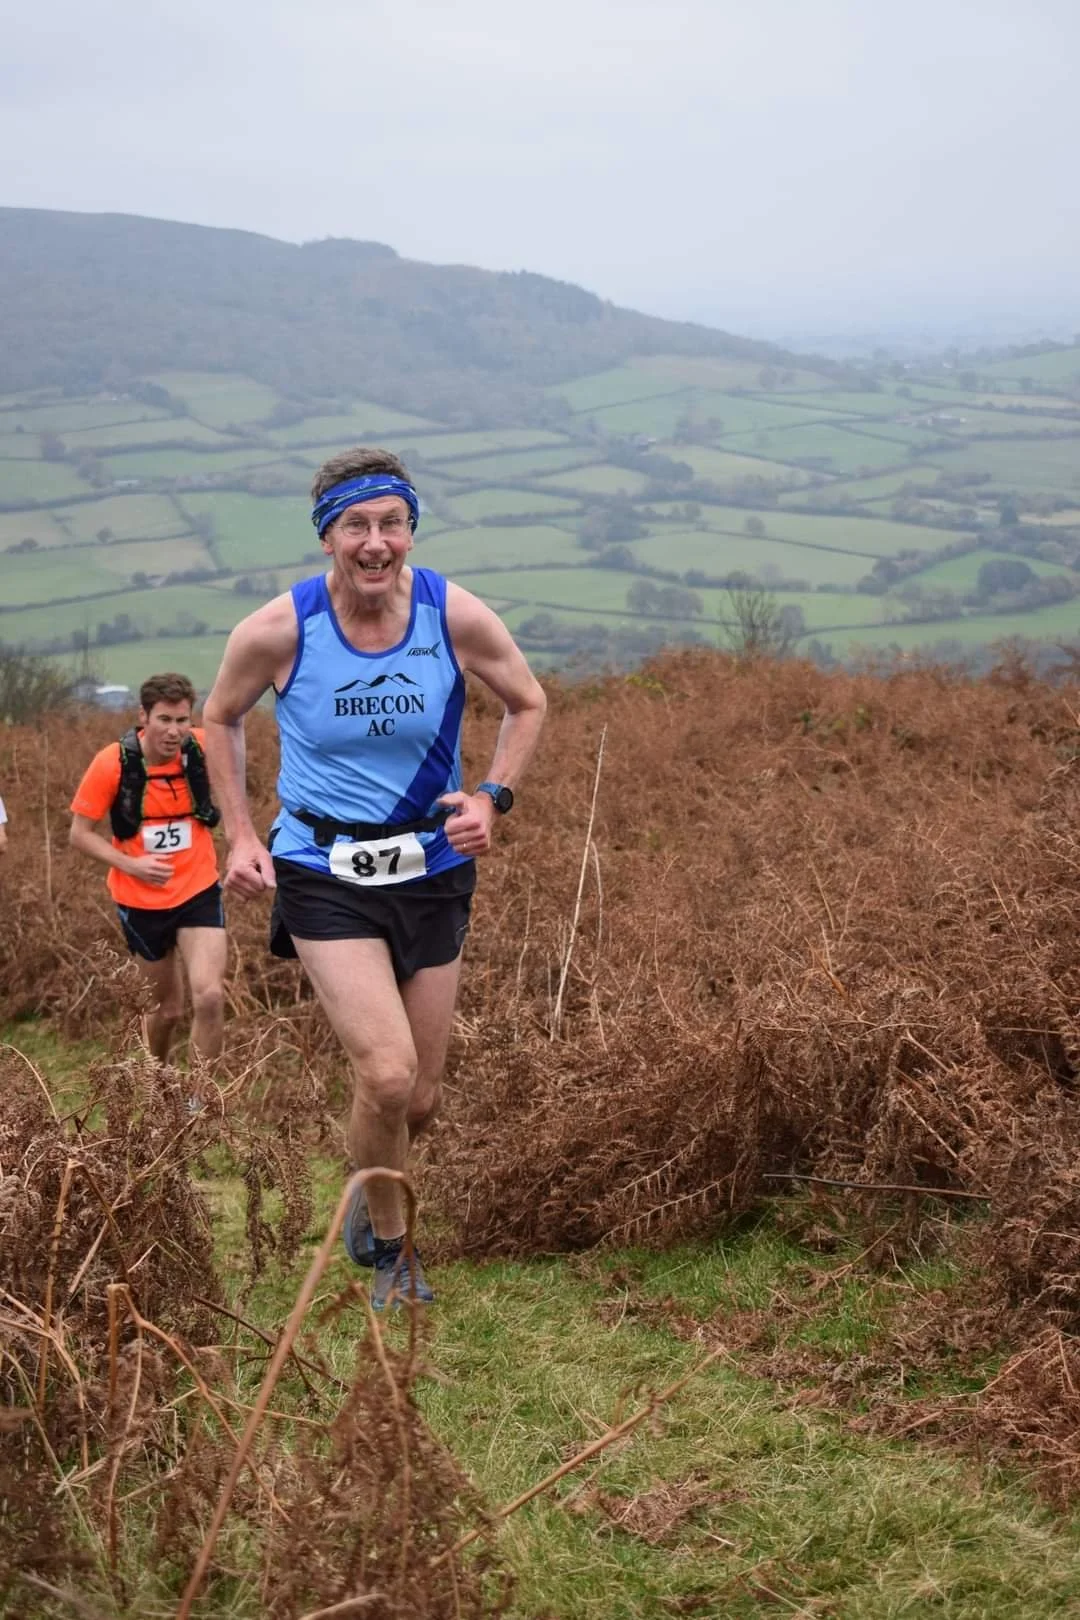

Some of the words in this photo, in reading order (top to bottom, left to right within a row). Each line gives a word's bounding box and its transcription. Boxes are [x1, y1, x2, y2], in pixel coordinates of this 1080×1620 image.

[334, 694, 425, 716] BRECON
[366, 718, 395, 736] AC
[154, 828, 180, 849] 25
[351, 845, 401, 877] 87
